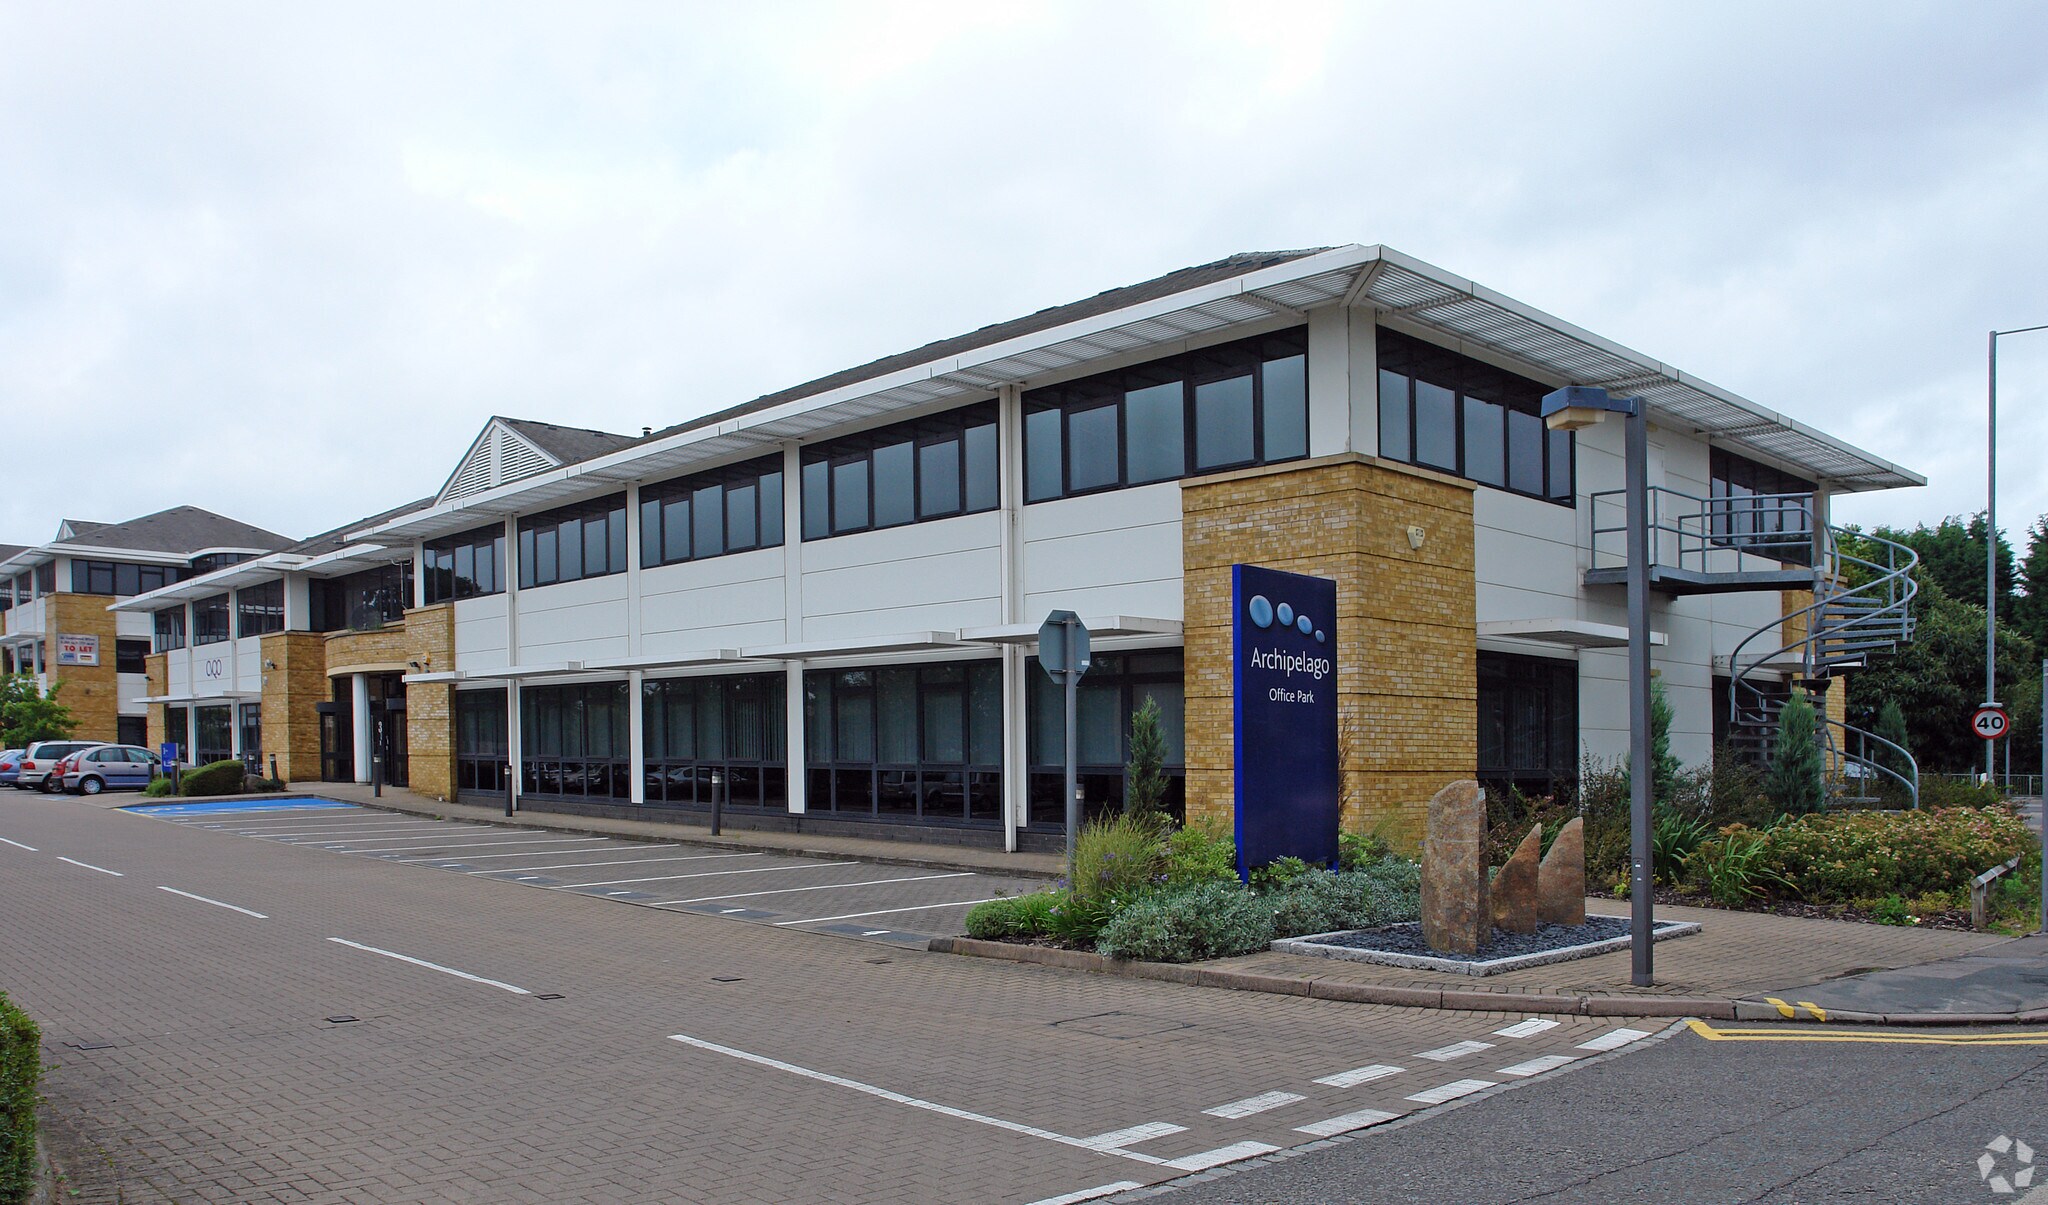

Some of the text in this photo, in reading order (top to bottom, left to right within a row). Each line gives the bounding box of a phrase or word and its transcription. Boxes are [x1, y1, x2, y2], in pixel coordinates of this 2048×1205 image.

[1250, 647, 1330, 680] Archipelago
[1269, 688, 1315, 704] Office Park
[1976, 716, 2004, 730] 40
